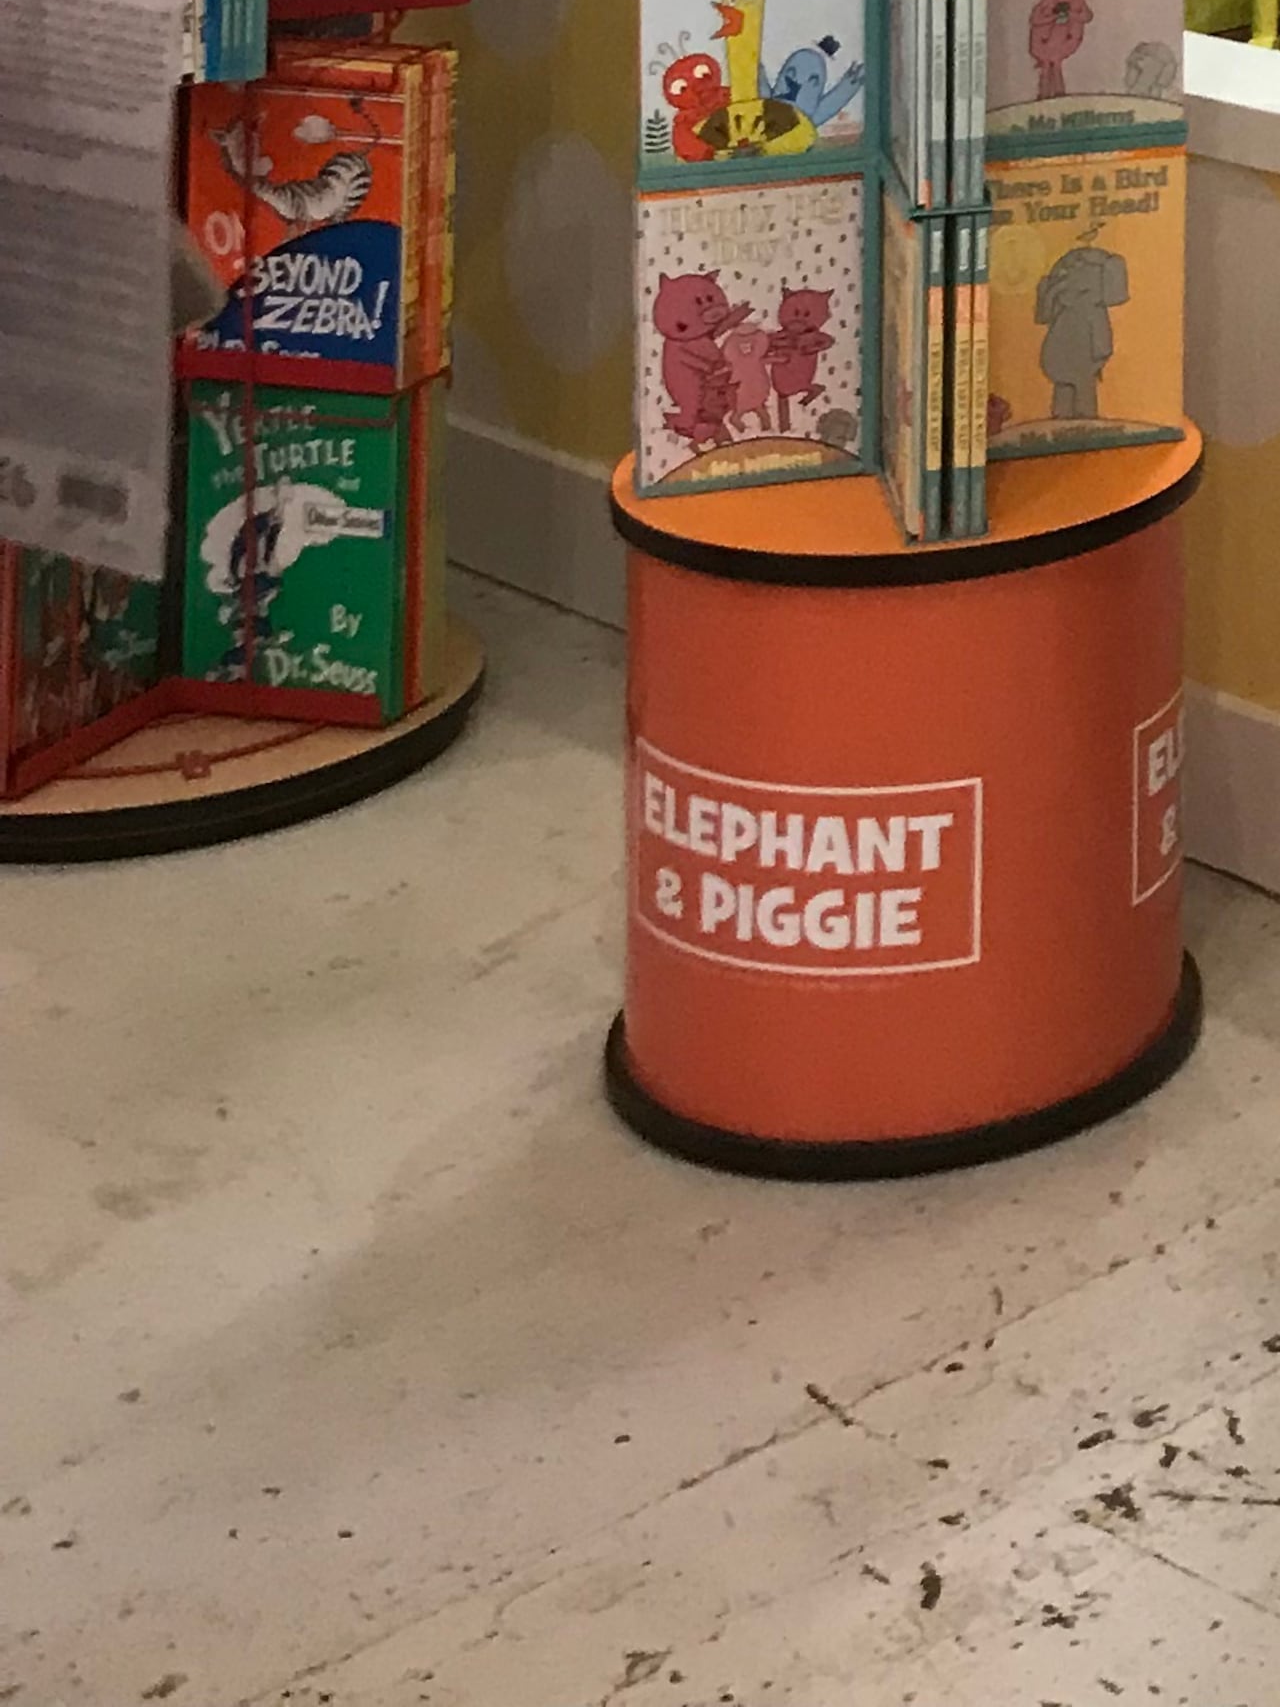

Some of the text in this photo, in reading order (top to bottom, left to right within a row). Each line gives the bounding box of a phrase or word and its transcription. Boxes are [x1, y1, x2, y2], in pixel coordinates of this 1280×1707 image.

[1091, 175, 1107, 191] A
[1115, 165, 1168, 190] Bird
[1023, 201, 1080, 223] Your
[233, 253, 362, 298] BEYOND
[253, 280, 389, 340] ZEBRA!
[253, 439, 356, 480] TURTLE
[329, 604, 363, 638] By
[264, 643, 378, 696] Dr. Seuss
[642, 770, 954, 875] ELEPHANT
[655, 866, 923, 949] & PIGGIE
